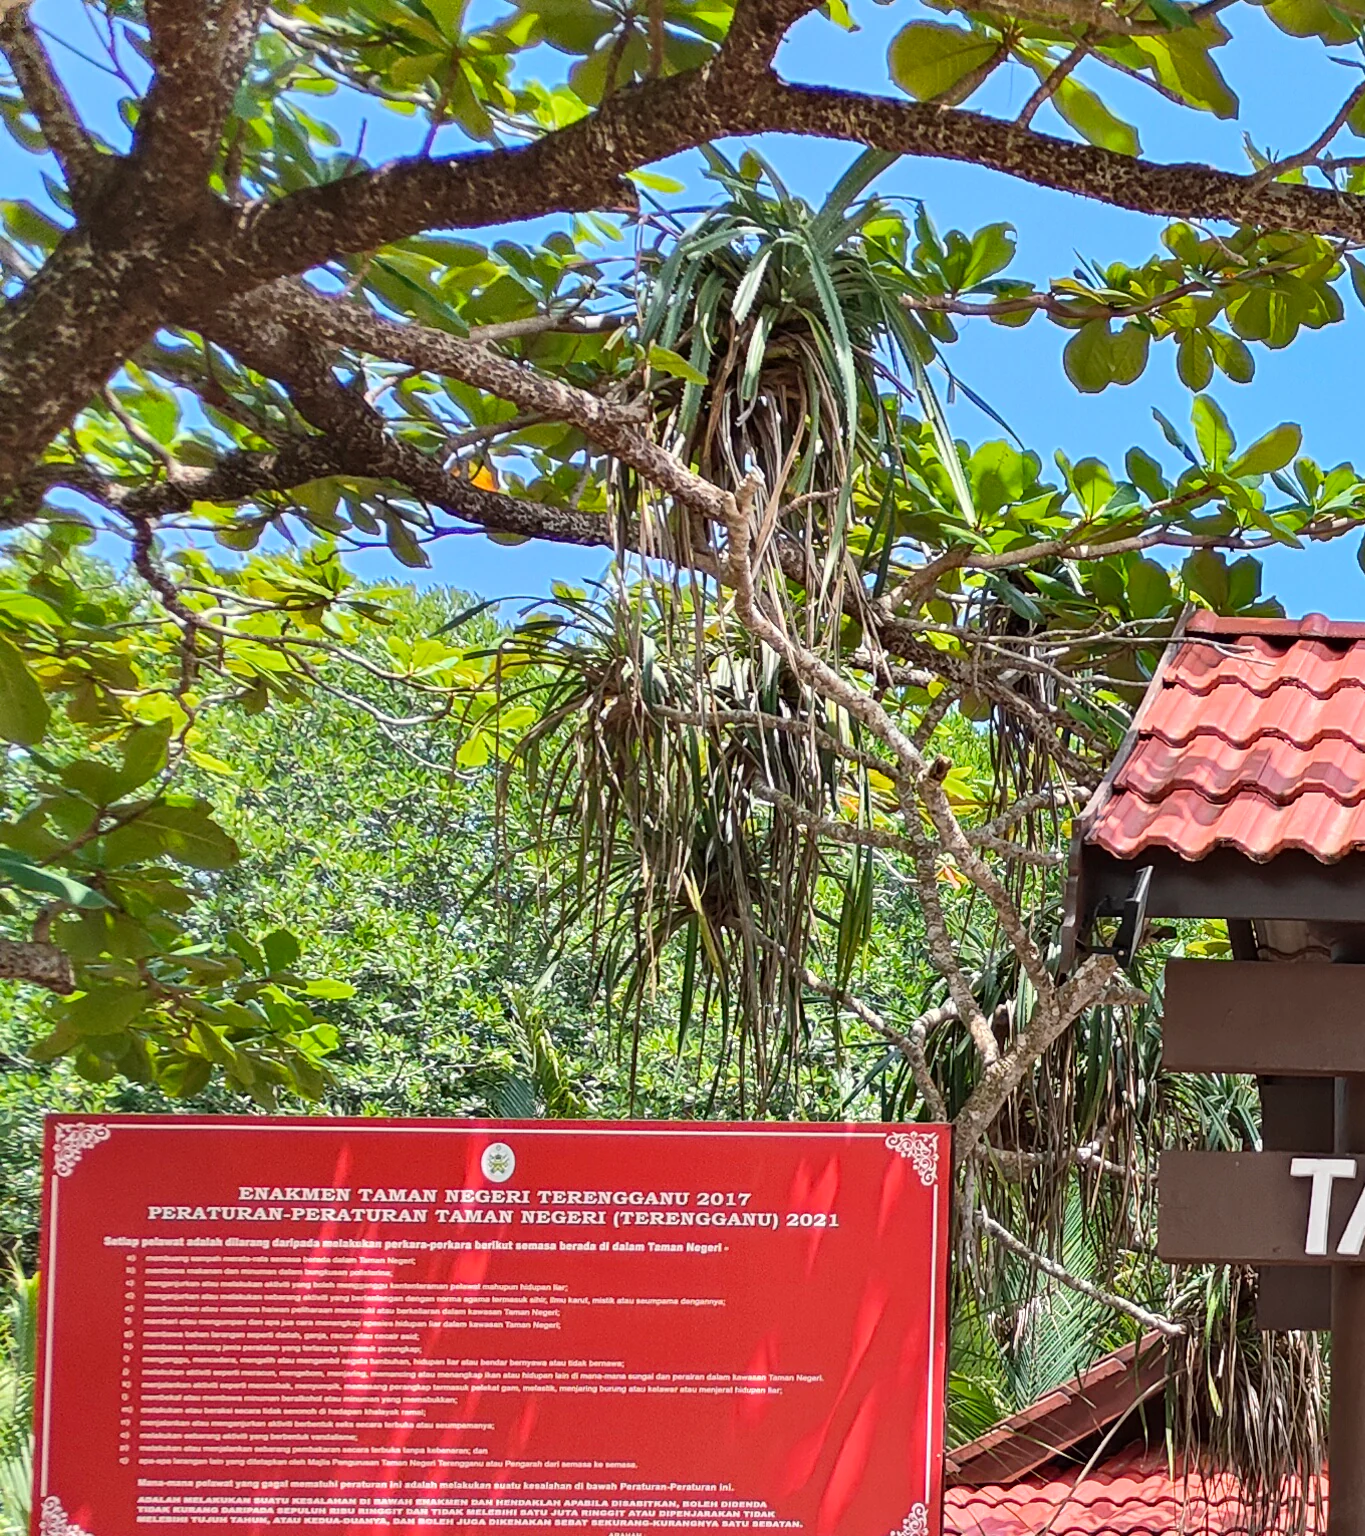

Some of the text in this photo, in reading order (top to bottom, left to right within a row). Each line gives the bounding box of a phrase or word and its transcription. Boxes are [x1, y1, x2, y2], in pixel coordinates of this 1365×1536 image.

[238, 1187, 751, 1205] ENAKMEN TAMAN NEGERI TERENGGANU 2017
[147, 1206, 839, 1227] PERATURAN-PERATURAN TAMAN NEGERI (TERENGGANU) 2021
[384, 1239, 471, 1250] perkara-perkara
[474, 1240, 513, 1249] berikut
[515, 1242, 556, 1250] semasa
[559, 1241, 596, 1250] berada
[599, 1241, 609, 1250] di
[612, 1242, 644, 1251] dalam
[647, 1242, 683, 1251] Taman
[686, 1242, 721, 1253] Negeri
[195, 1479, 233, 1488] pelawat
[235, 1481, 259, 1489] yang
[261, 1480, 288, 1489] gagal
[340, 1481, 387, 1489] peraturan
[389, 1480, 402, 1488] ini
[439, 1481, 491, 1489] melakukan
[574, 1482, 583, 1490] di
[586, 1482, 617, 1490] bawah
[620, 1482, 716, 1490] Peraturan-Peraturan
[719, 1483, 734, 1491] ini.
[230, 1516, 270, 1524] TAHUN,
